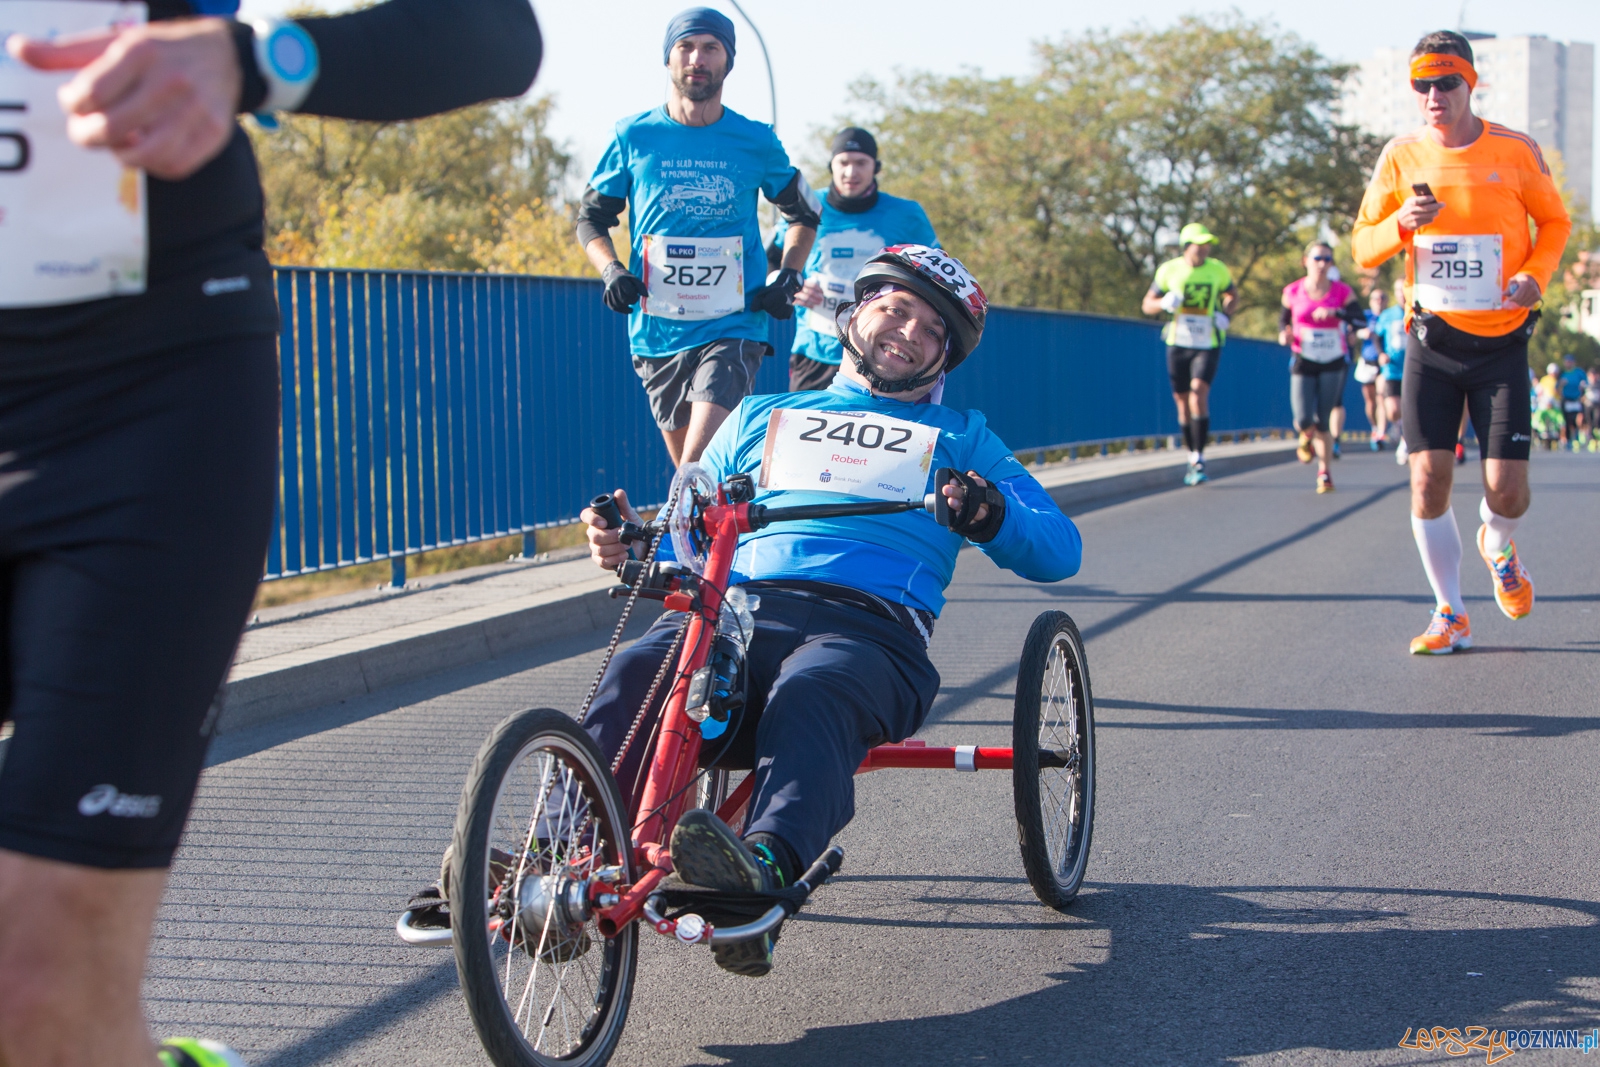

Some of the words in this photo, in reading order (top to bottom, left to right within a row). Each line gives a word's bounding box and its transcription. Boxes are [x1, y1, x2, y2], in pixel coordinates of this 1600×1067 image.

[662, 264, 727, 286] 2627
[1431, 260, 1483, 278] 2193
[799, 416, 913, 453] 2402
[831, 454, 868, 466] Robert
